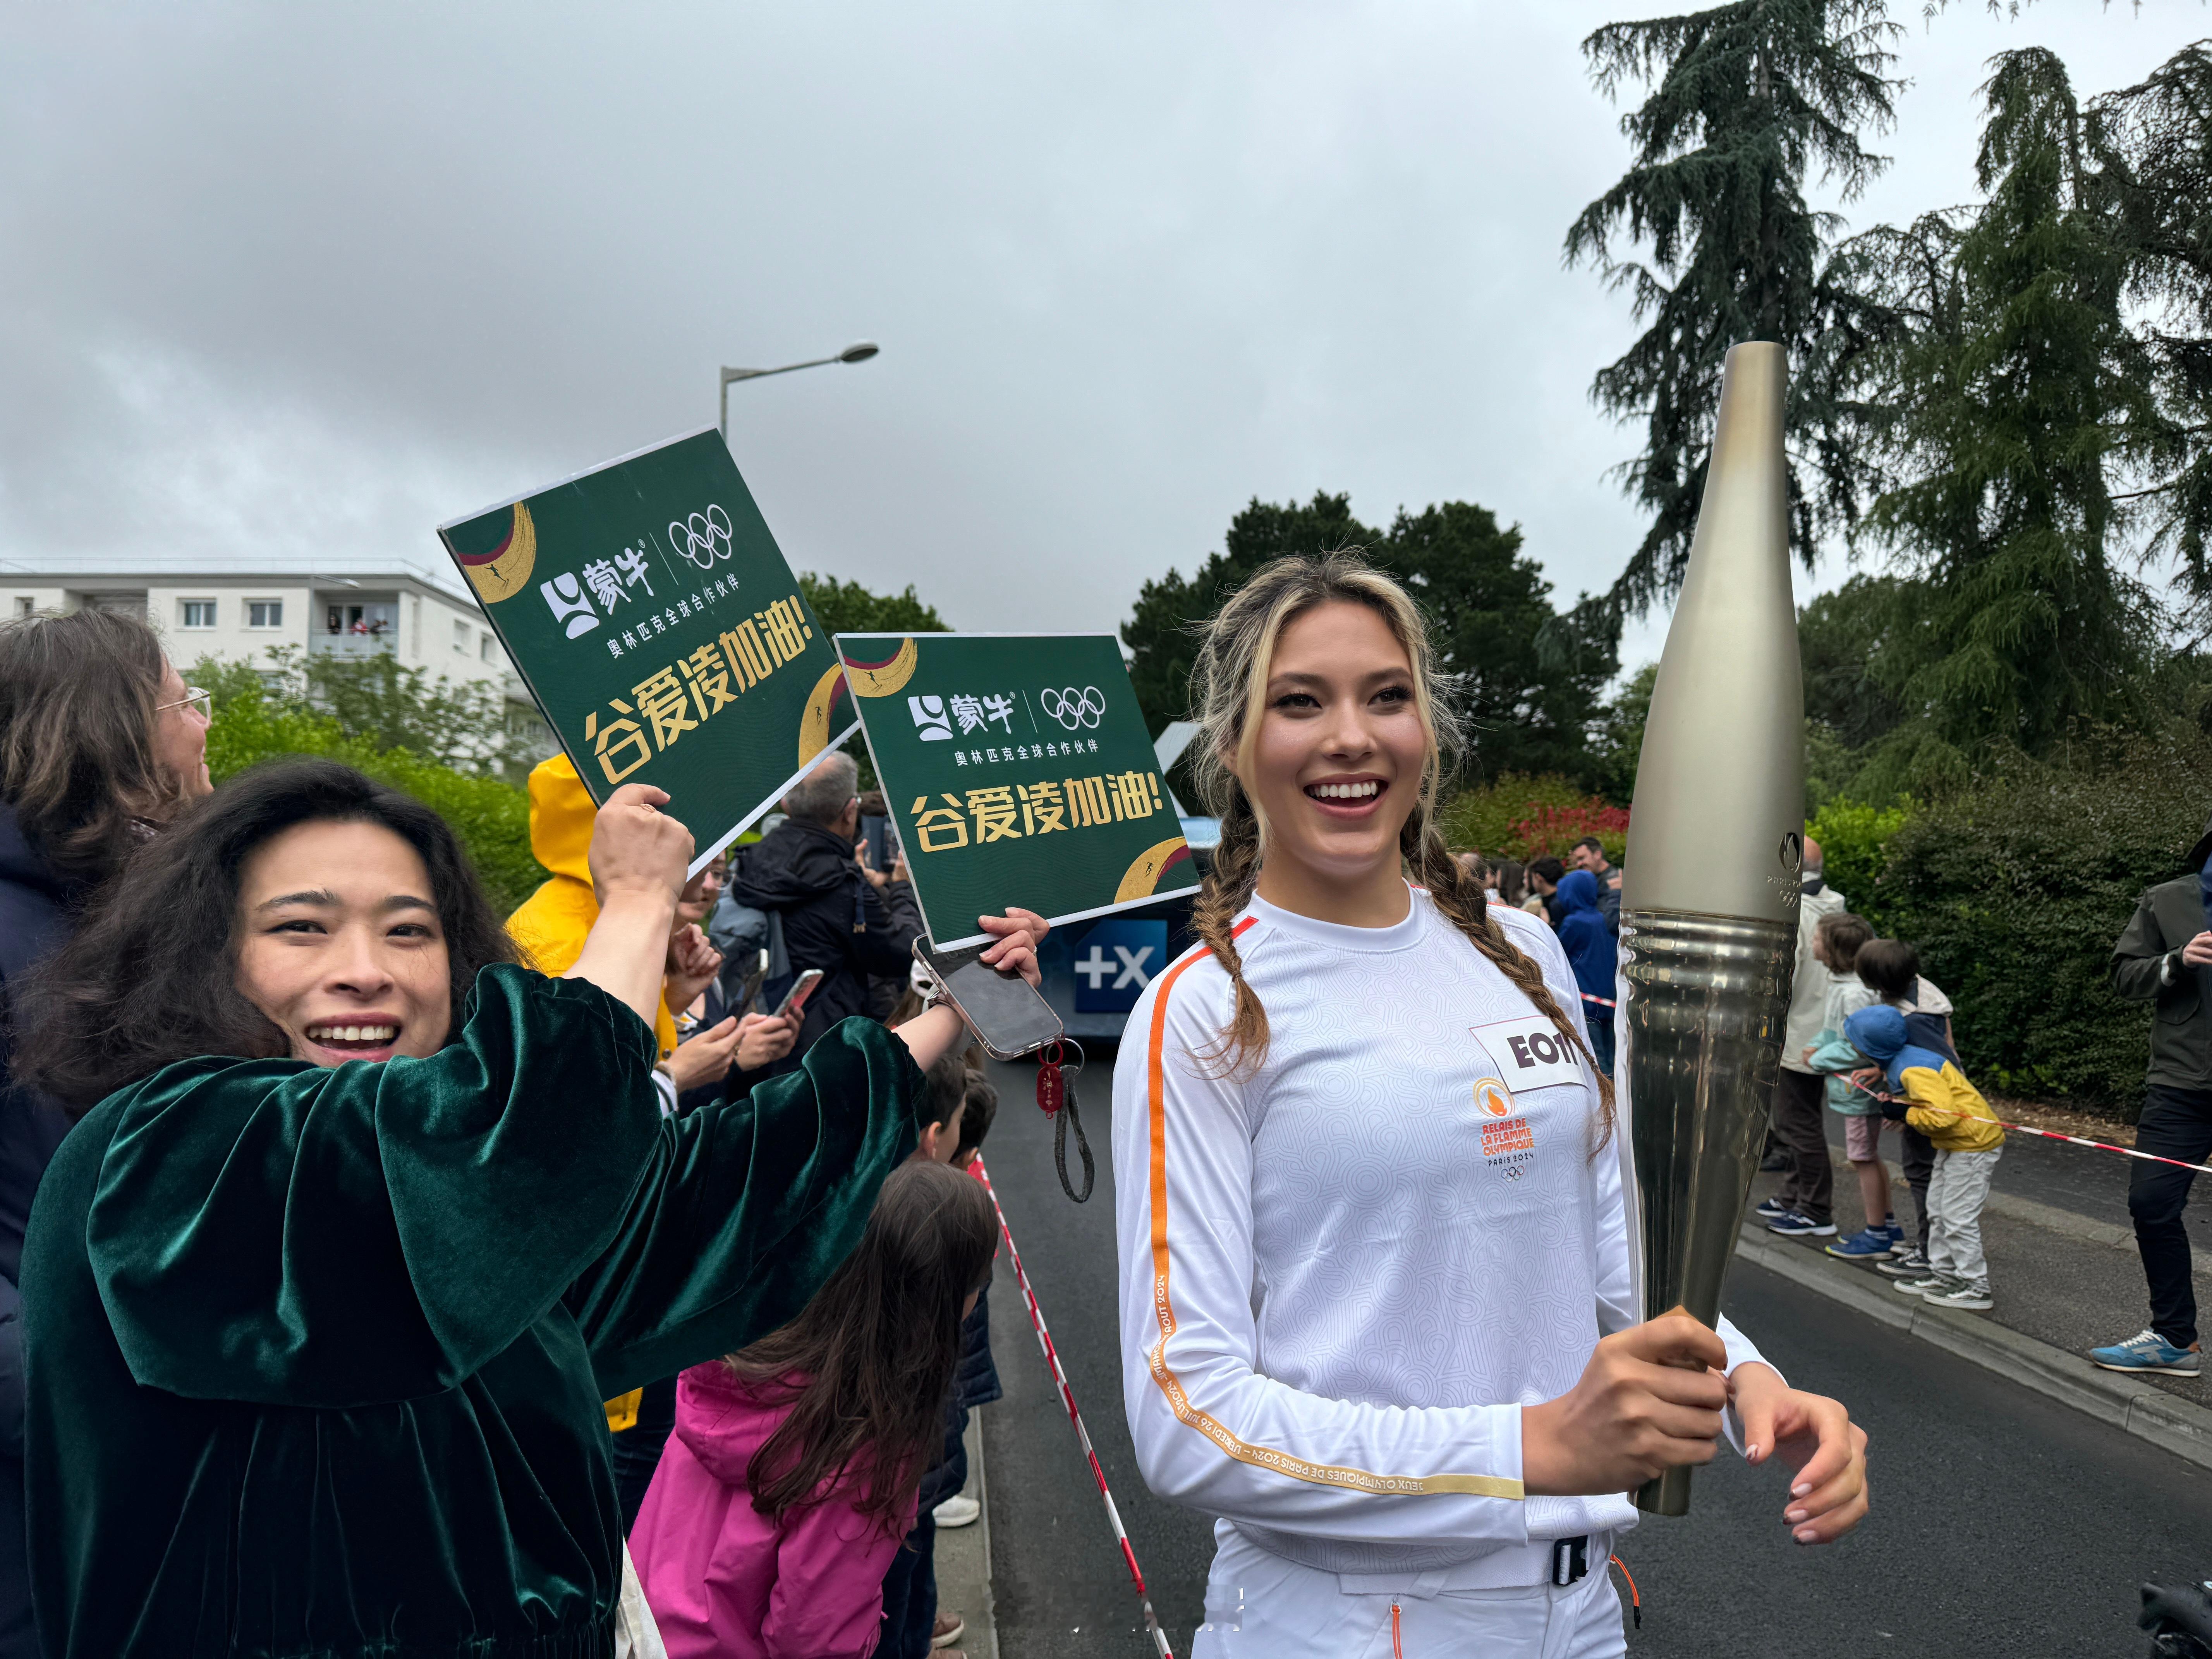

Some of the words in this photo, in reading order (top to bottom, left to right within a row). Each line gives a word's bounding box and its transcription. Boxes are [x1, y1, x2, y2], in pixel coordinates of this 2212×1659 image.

[607, 572, 739, 659] 奥林匹克全球合作伙伴
[954, 738, 1098, 766] 奥林匹克全球合作伙伴
[1482, 1119, 1514, 1135] RELAIS
[1515, 1117, 1527, 1129] DE
[1480, 1134, 1492, 1146] LA
[1493, 1127, 1532, 1144] FLAMME
[1483, 1137, 1535, 1156] OLYMPIQUE
[1513, 1152, 1534, 1162] 2024
[1157, 1274, 1165, 1304] 2024
[1167, 1380, 1184, 1406] 2024
[1201, 1418, 1214, 1431] 26
[1252, 1449, 1280, 1465] 2024
[1280, 1458, 1309, 1475] PARIS
[1311, 1467, 1325, 1479] DE
[1327, 1470, 1396, 1489] OLYMPIQUES
[1398, 1479, 1423, 1492] JEUX
